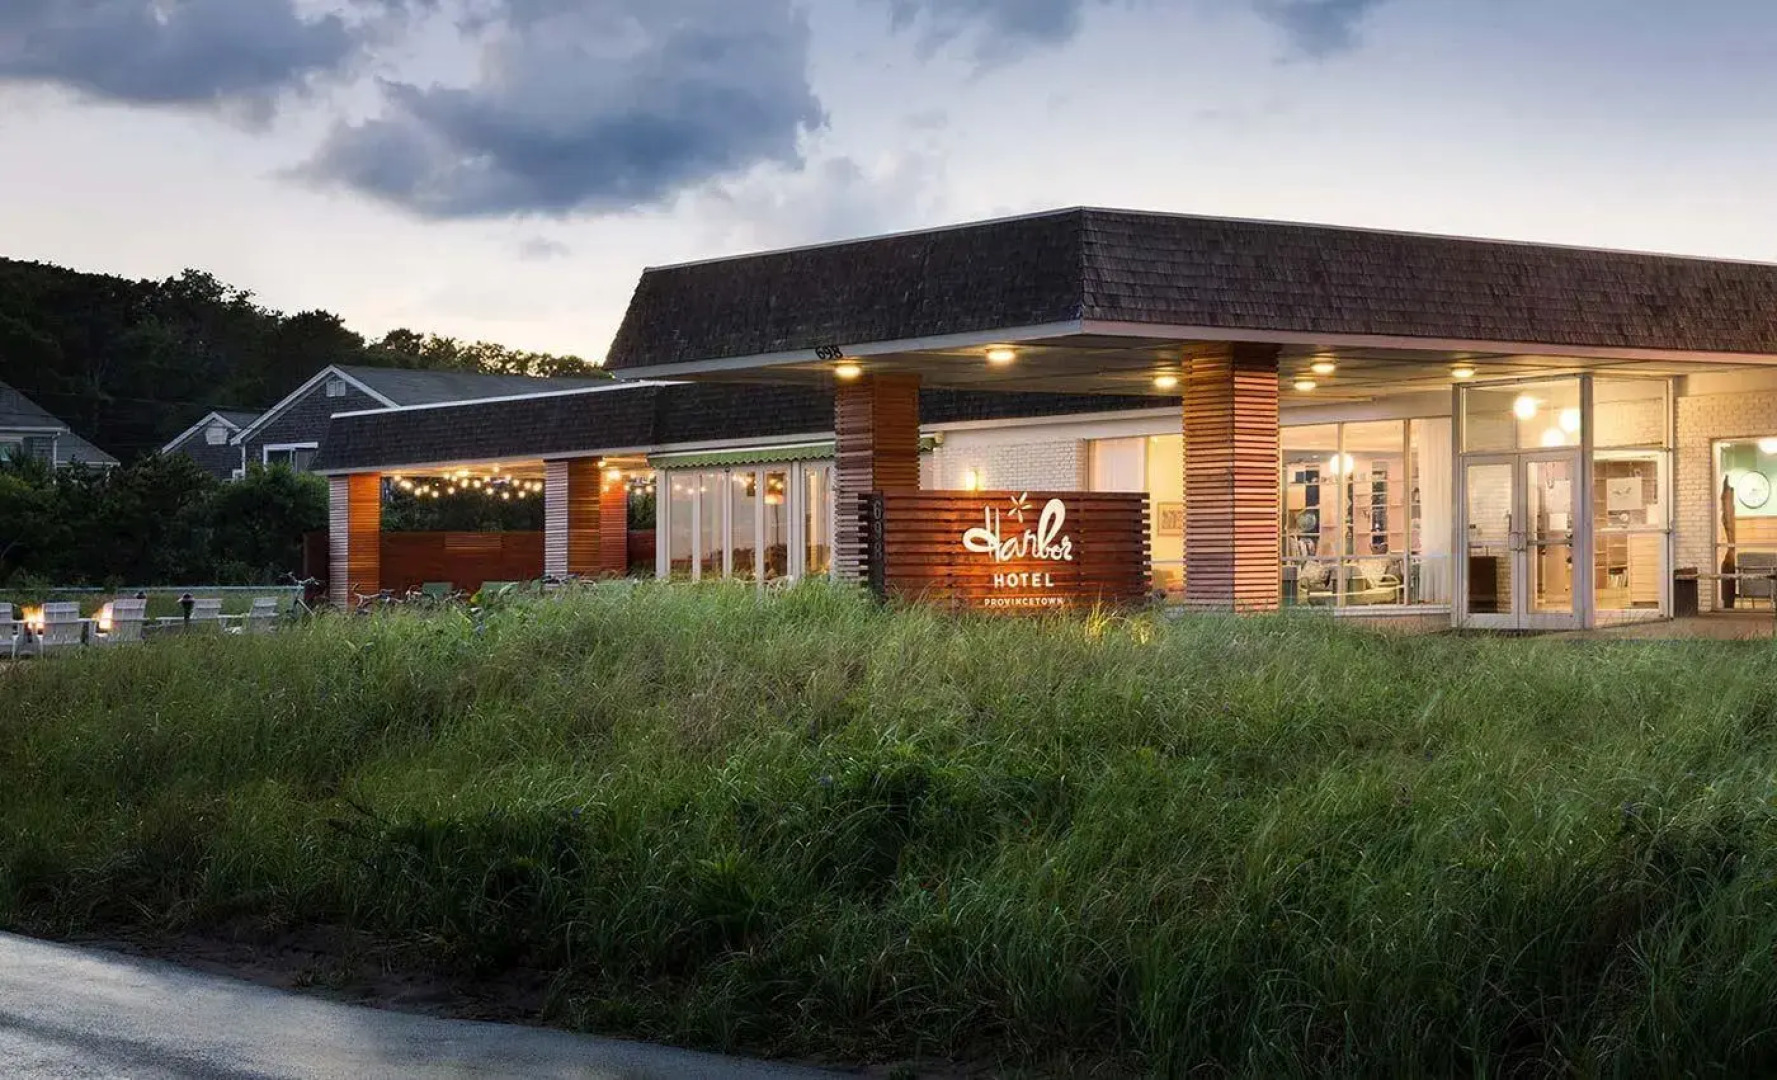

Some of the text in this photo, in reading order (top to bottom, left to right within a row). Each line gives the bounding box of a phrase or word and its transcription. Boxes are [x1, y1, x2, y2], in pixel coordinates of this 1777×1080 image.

[815, 344, 843, 359] 698
[962, 498, 1073, 562] Harbor
[994, 573, 1055, 588] HOTEL
[984, 597, 1064, 606] PROVINCETOWN
